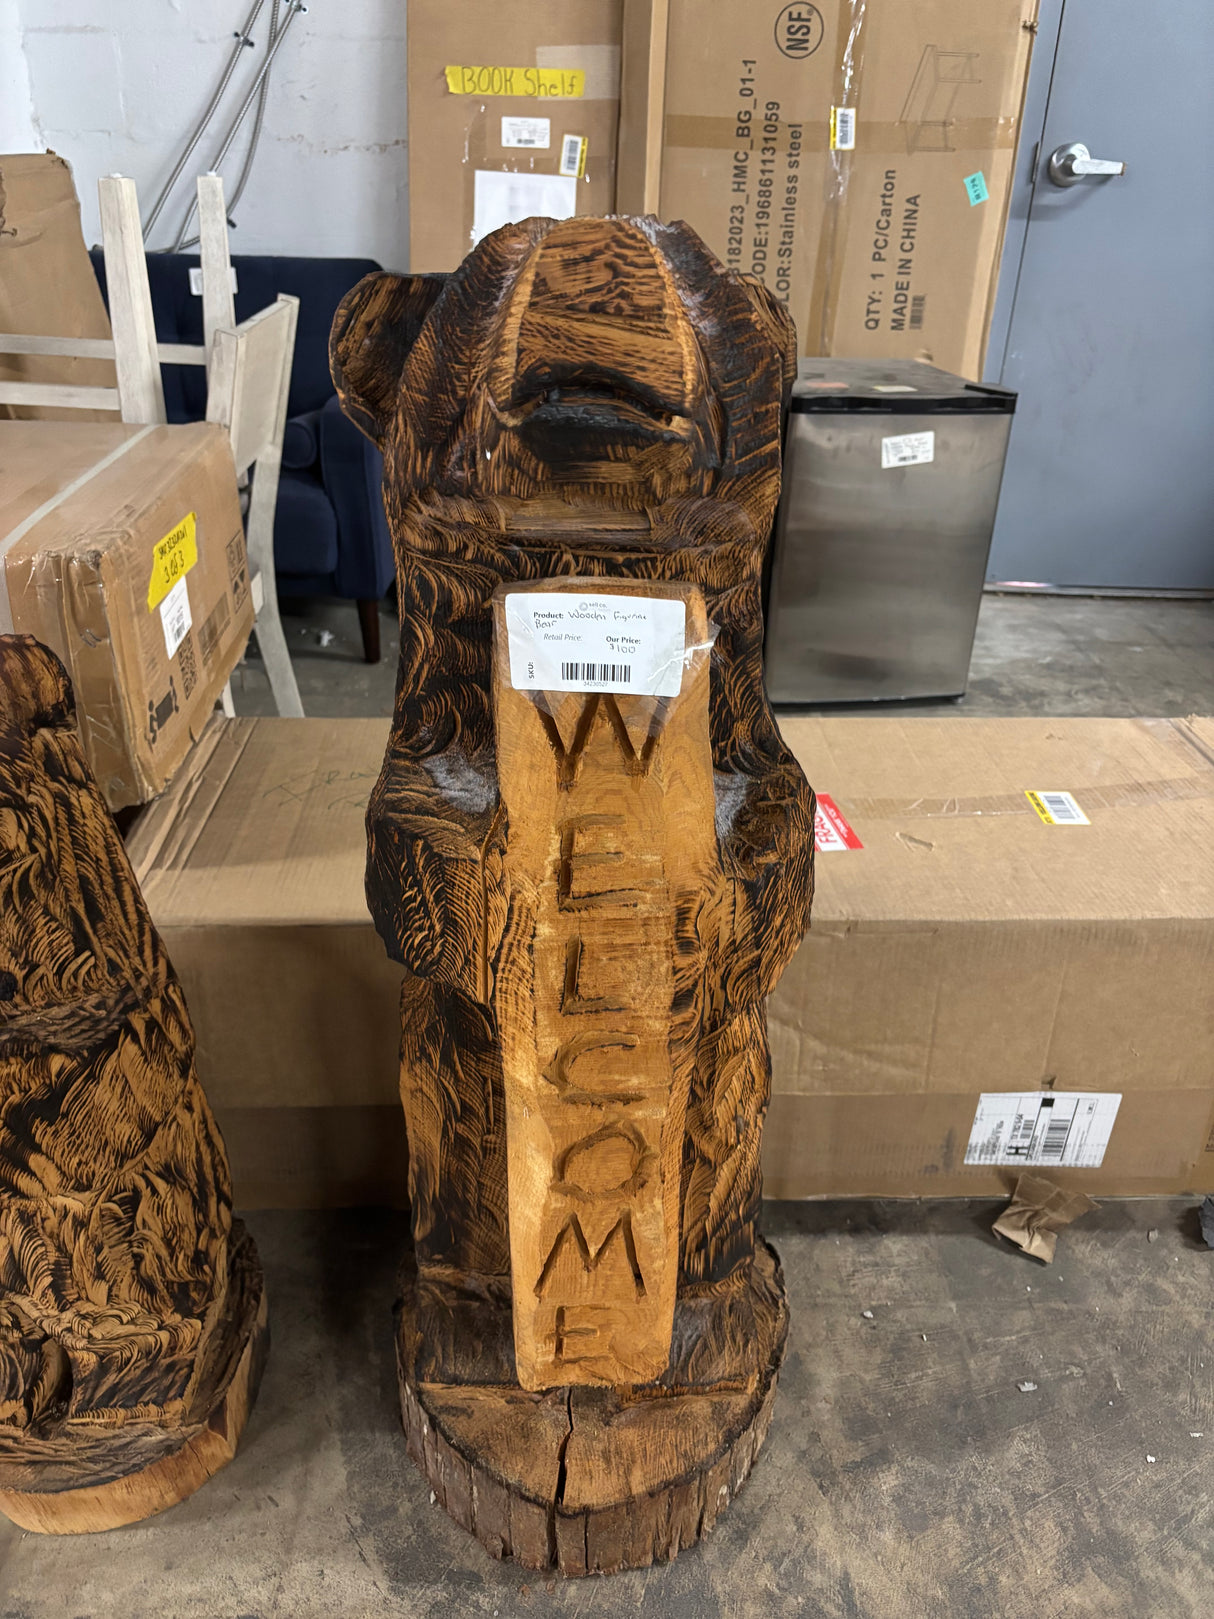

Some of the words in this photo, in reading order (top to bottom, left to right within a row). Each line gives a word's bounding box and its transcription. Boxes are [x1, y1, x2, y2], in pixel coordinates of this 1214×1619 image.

[785, 11, 811, 51] NSF
[461, 66, 514, 95] BOOK
[524, 68, 577, 97] Shelf
[786, 124, 803, 169] steel
[751, 101, 780, 284] ODE:196861131059
[872, 169, 897, 262] PC/Carton
[900, 194, 921, 253] CHINA
[776, 174, 799, 311] LOR:Stainless
[897, 258, 913, 275] IN
[865, 290, 883, 331] QTY:
[890, 281, 911, 331] MADE
[533, 611, 564, 619] Product:
[543, 633, 563, 641] Retail
[605, 635, 620, 643] Our
[621, 636, 641, 645] Price:
